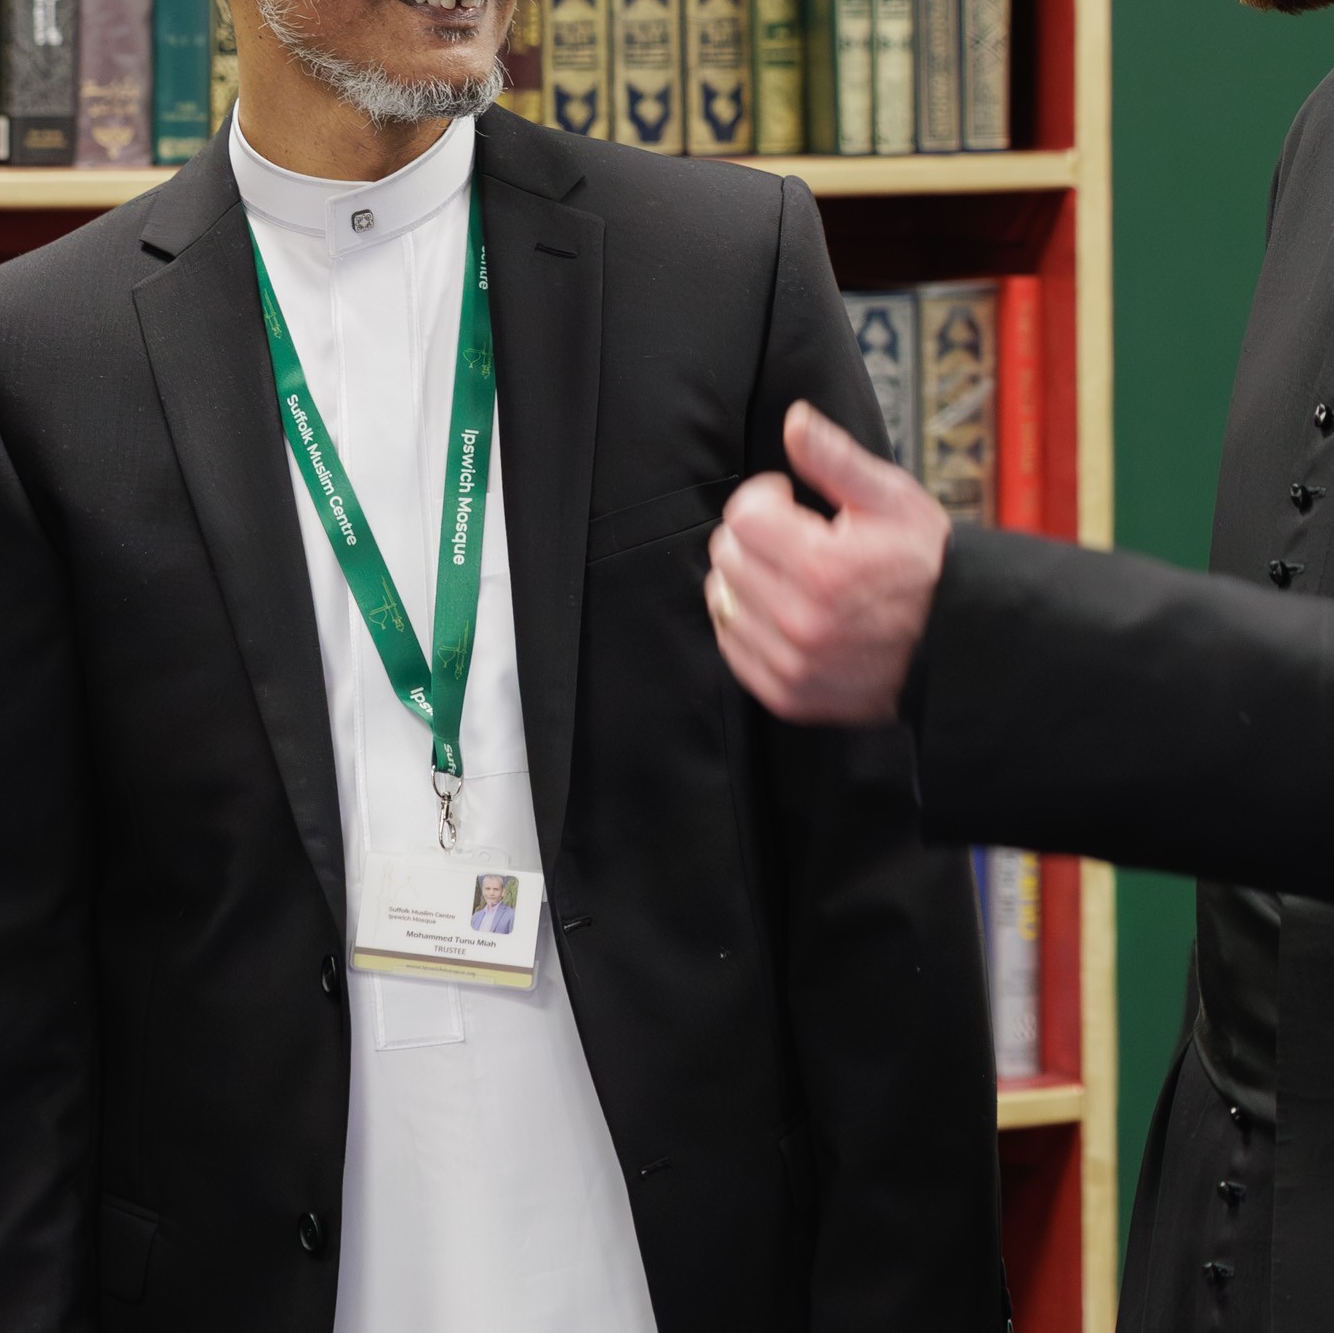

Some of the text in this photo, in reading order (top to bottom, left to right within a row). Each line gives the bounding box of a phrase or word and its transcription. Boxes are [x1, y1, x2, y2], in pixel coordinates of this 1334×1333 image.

[286, 393, 357, 547] Suffolk Muslim Centre
[452, 428, 480, 566] Ipswich Mosque
[389, 906, 455, 920] Suffolk Muslim Centre
[389, 914, 436, 925] Ipswich Mosque
[406, 930, 496, 948] Mohammed Tunu Miah
[434, 945, 466, 956] TRUSTEE
